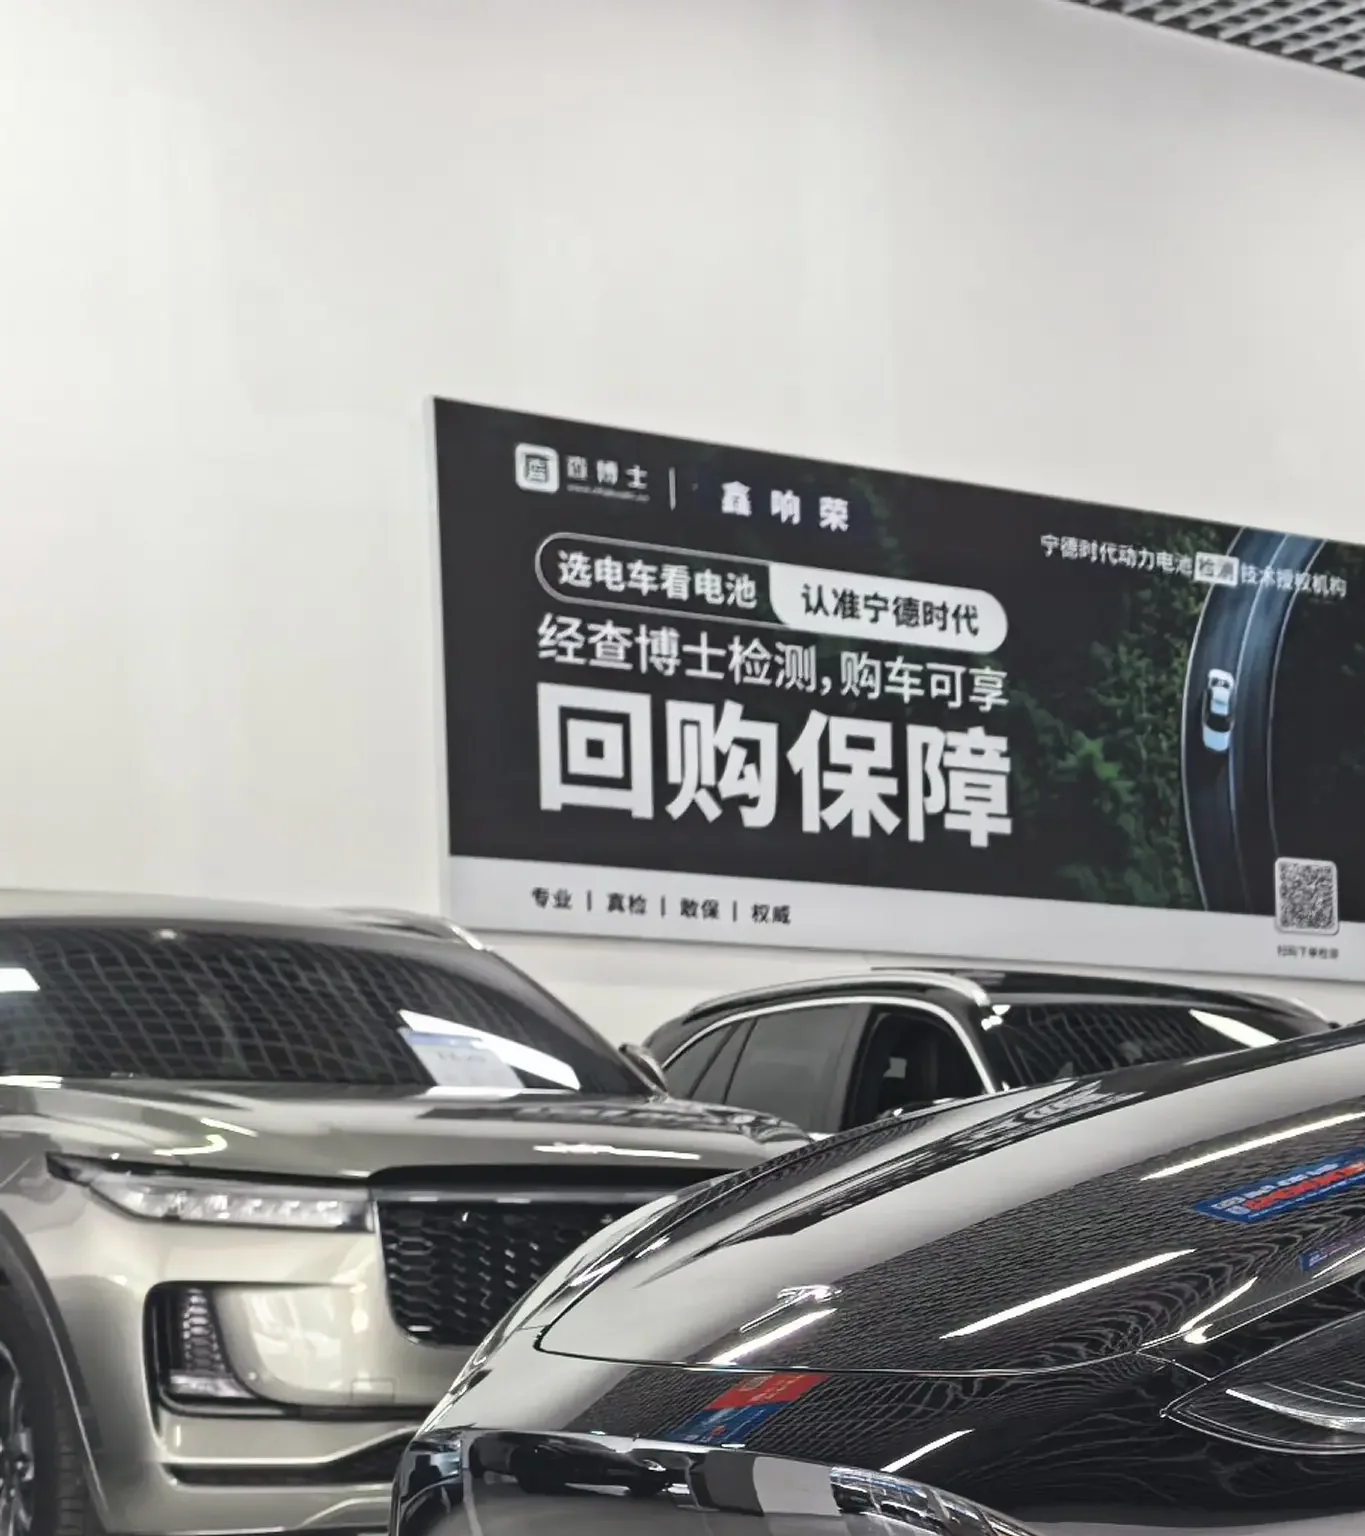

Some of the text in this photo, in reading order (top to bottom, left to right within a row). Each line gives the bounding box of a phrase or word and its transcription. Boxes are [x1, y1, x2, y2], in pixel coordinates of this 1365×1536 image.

[721, 480, 850, 531] 鑫响荣
[558, 549, 980, 637] 选电车看电池 认准宁德时代
[536, 682, 1014, 849] 回购保障
[531, 886, 792, 925] 专业 真检 敢保 权威
